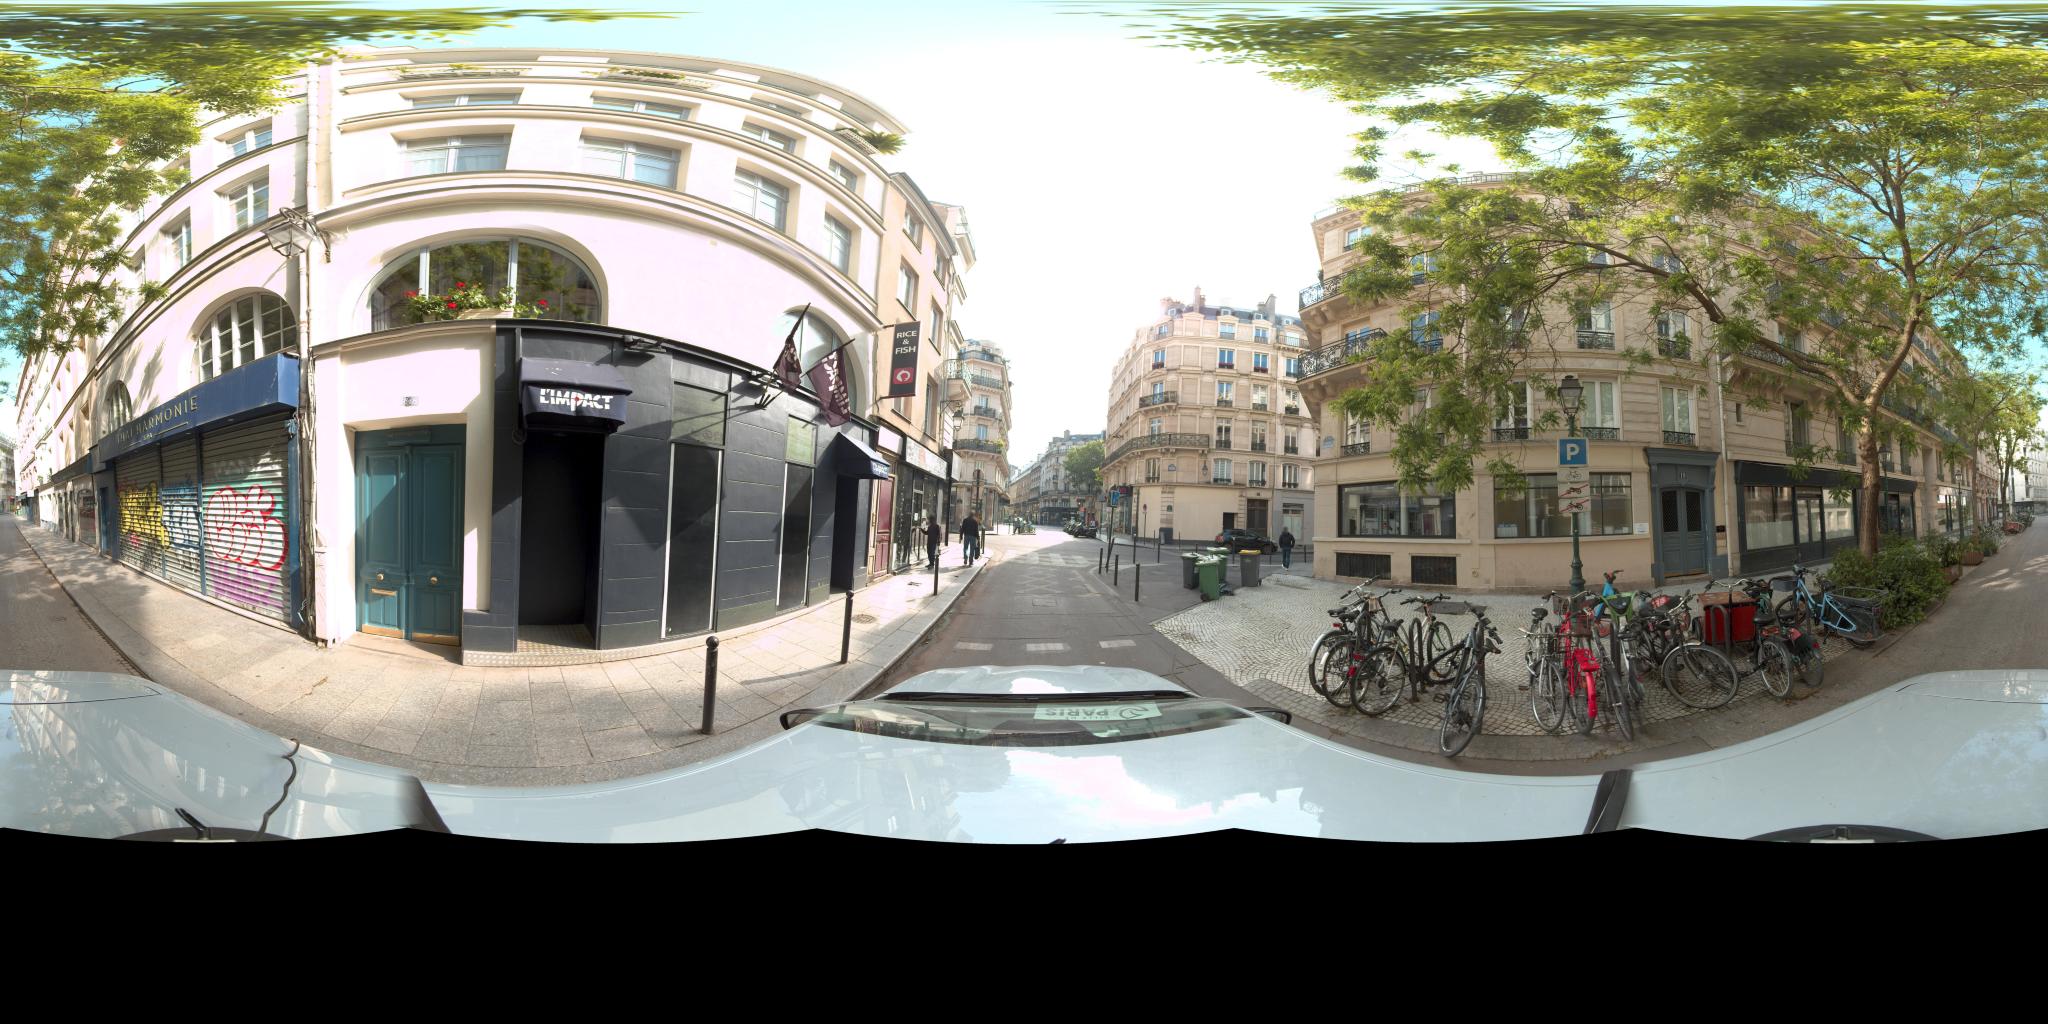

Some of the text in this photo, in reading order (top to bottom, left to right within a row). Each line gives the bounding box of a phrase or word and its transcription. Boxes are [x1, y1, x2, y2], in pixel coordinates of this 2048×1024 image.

[896, 325, 918, 339] RICE
[895, 345, 917, 355] FISH
[539, 388, 614, 412] L'IMPACT
[136, 395, 198, 435] HARMONIE
[1566, 443, 1580, 461] P
[1045, 708, 1109, 717] PARIS
